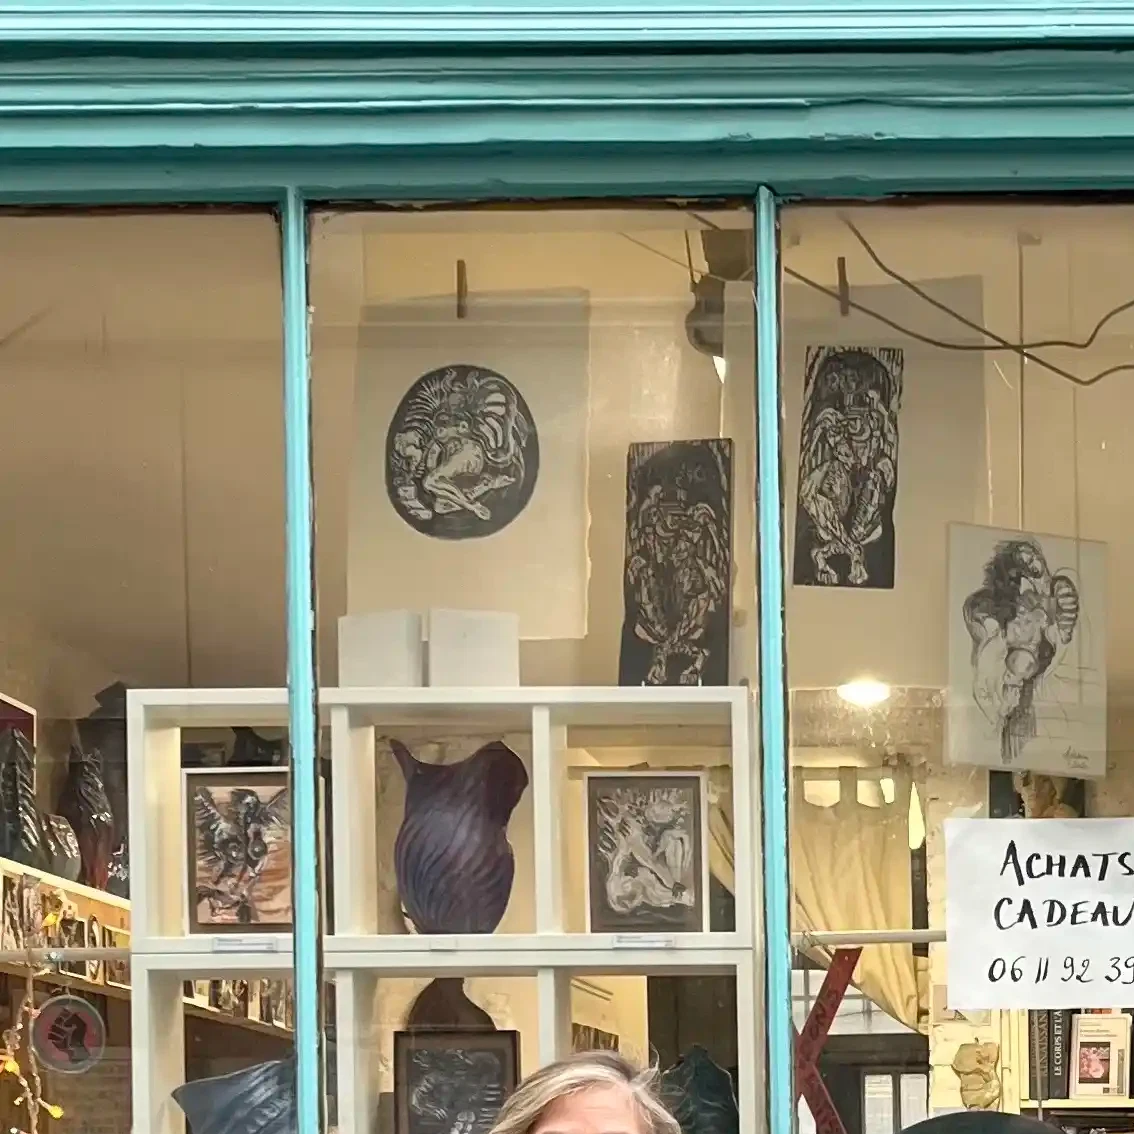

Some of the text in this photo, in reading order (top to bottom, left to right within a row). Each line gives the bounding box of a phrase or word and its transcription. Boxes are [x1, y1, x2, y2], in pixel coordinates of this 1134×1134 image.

[1000, 839, 1134, 886] ACHATS
[988, 955, 1026, 983] 06
[1034, 956, 1049, 984] 11
[1061, 956, 1094, 983] 92
[1054, 1023, 1062, 1035] ET
[1054, 1036, 1062, 1065] CORPS
[1054, 1065, 1062, 1076] LE
